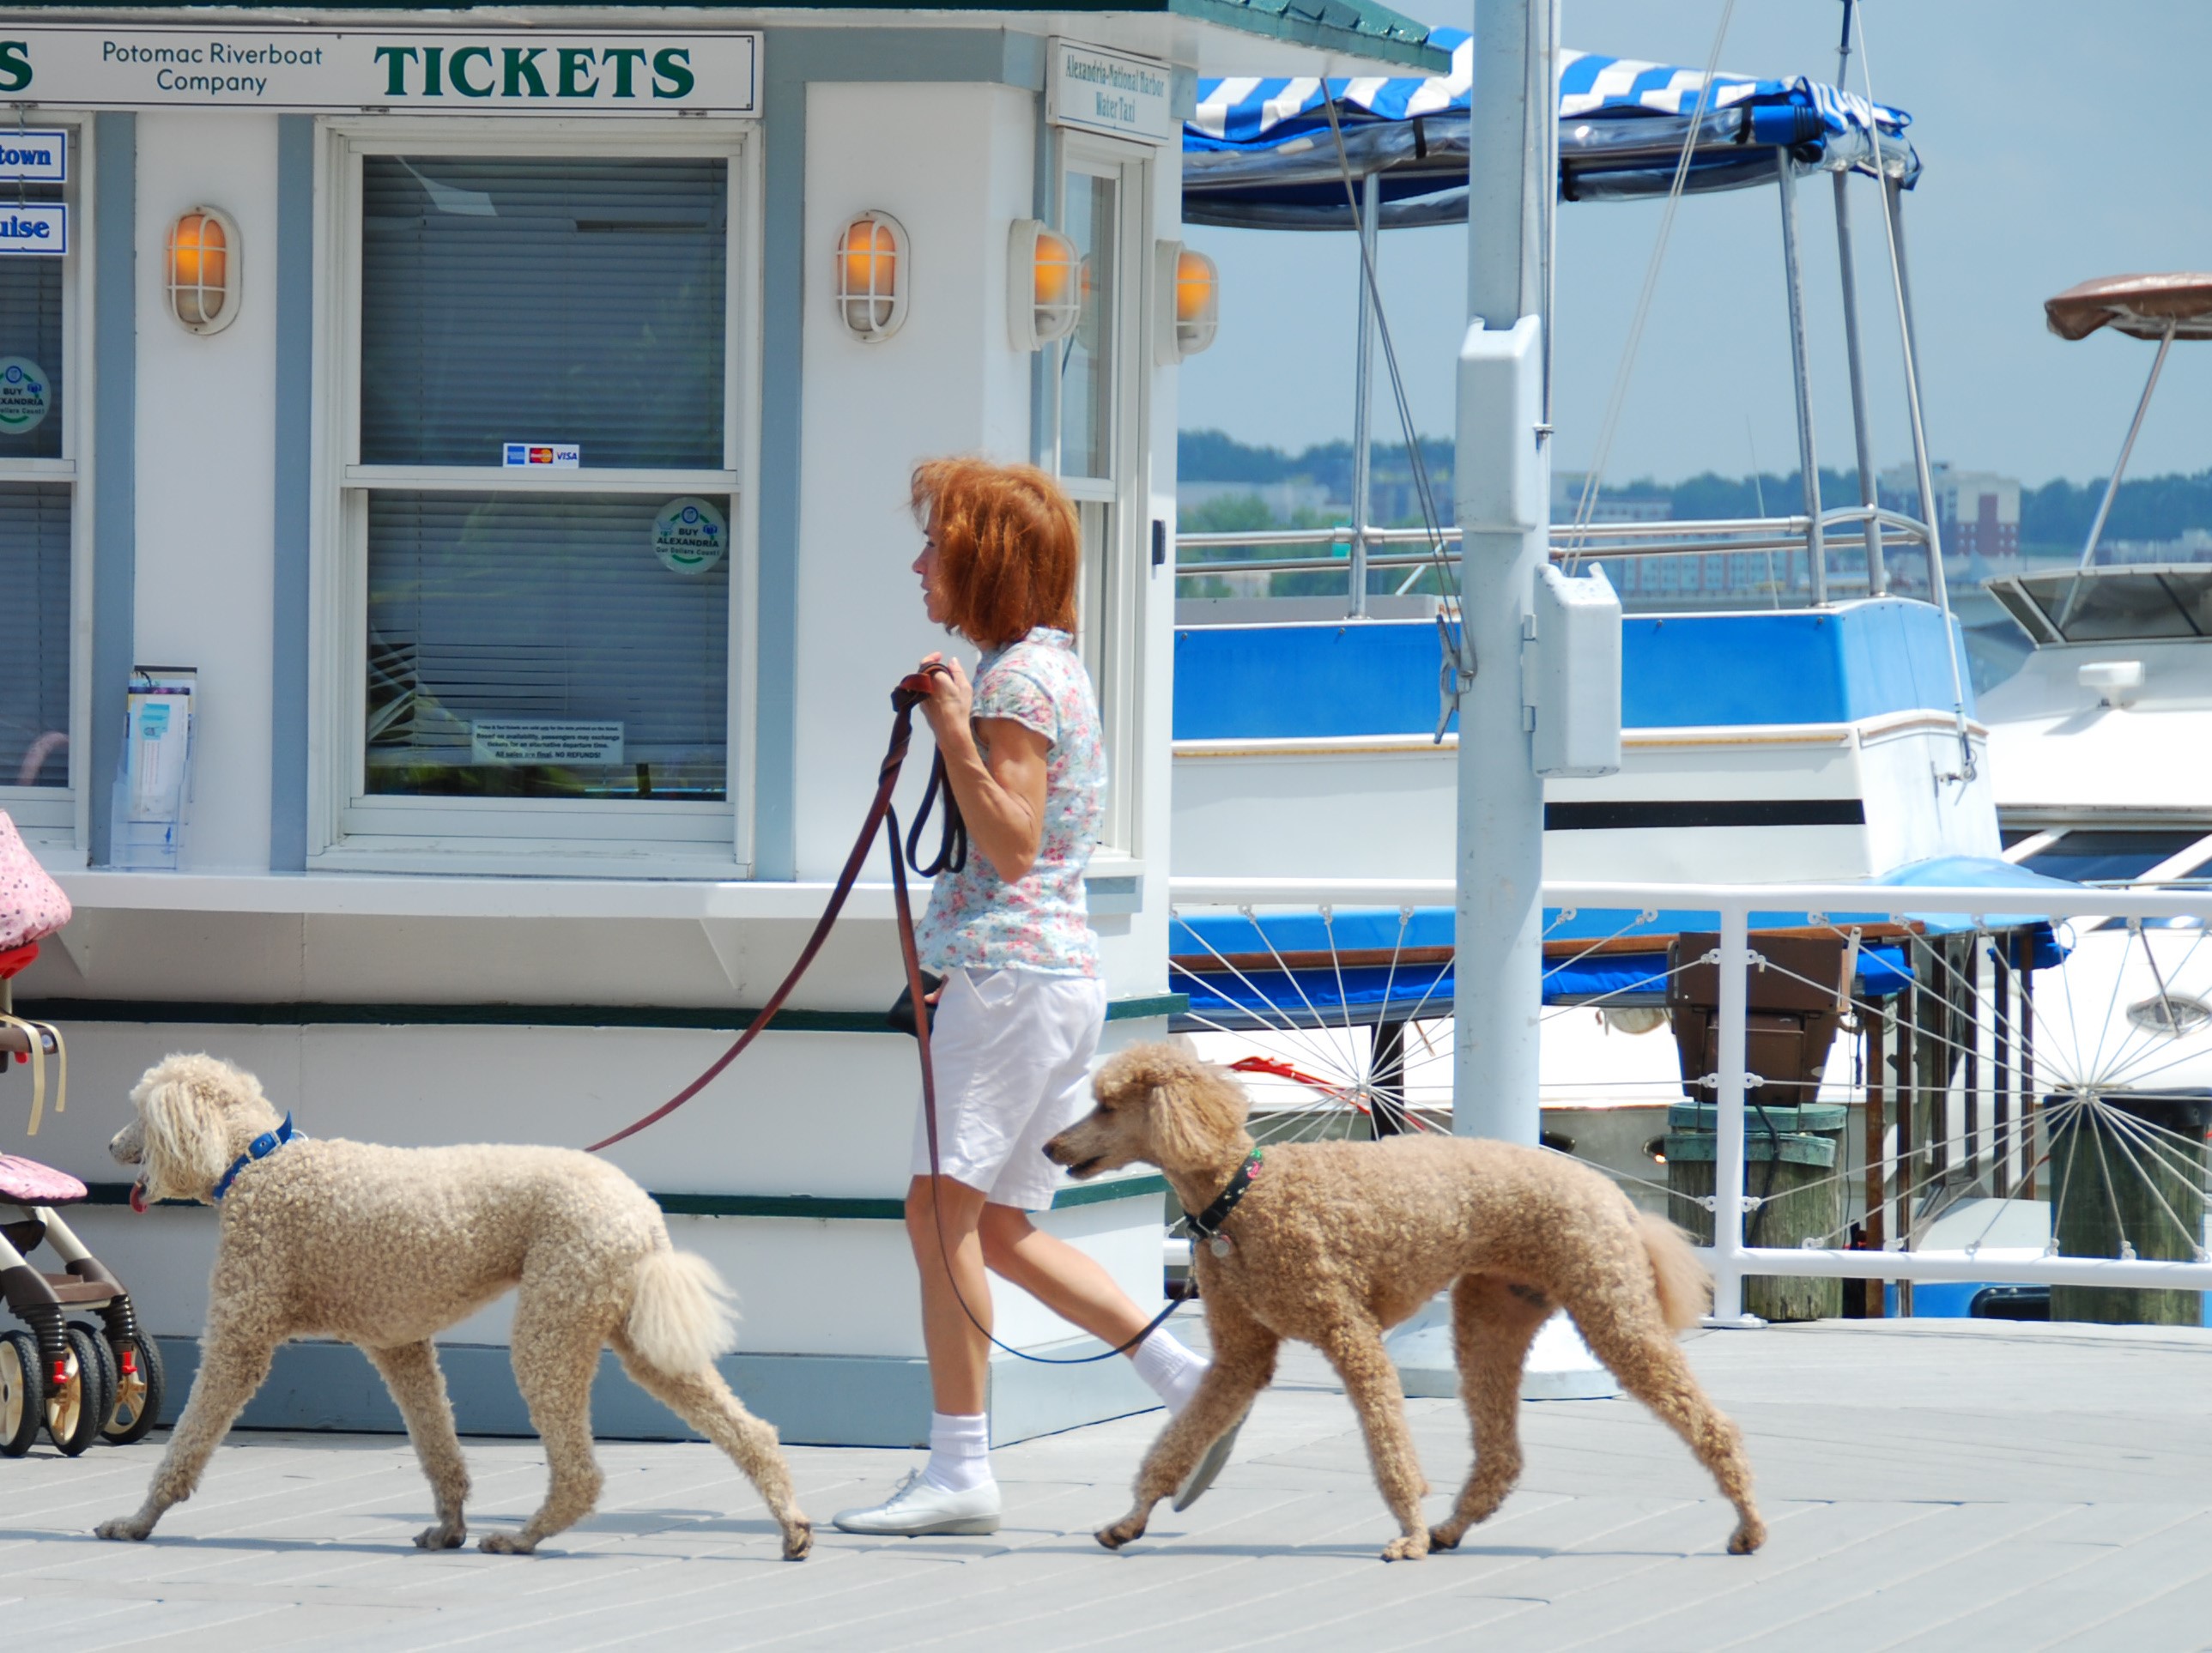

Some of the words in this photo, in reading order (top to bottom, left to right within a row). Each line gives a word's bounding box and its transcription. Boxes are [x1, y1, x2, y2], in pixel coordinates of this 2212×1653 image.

[103, 41, 203, 63] Potomac
[210, 43, 323, 64] Riverboat
[157, 69, 267, 96] Company
[373, 46, 695, 99] TICKETS
[1096, 92, 1118, 118] Water
[1118, 97, 1136, 122] Taxi
[657, 537, 719, 548] ALEXANDRIA
[678, 528, 699, 536] BUY
